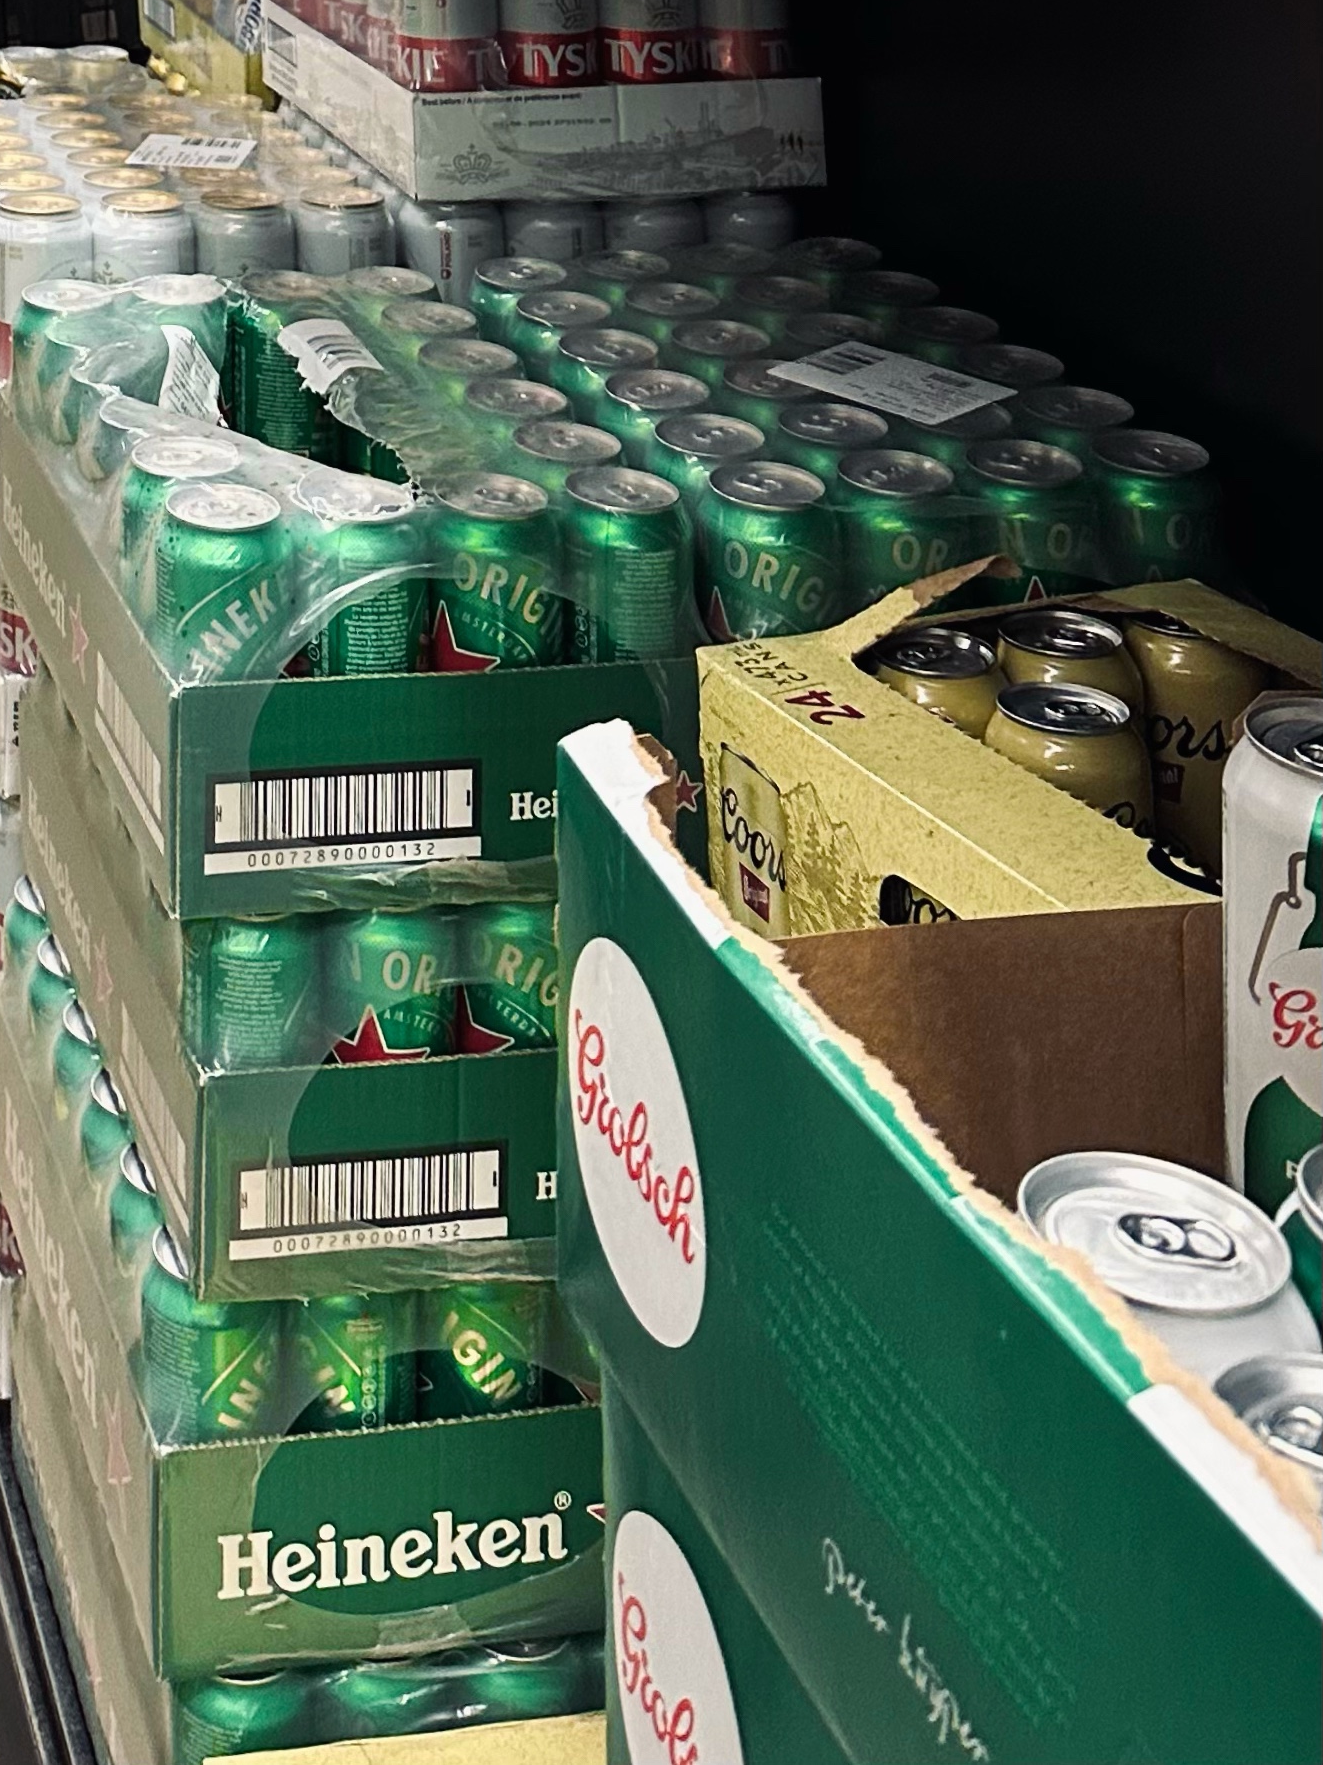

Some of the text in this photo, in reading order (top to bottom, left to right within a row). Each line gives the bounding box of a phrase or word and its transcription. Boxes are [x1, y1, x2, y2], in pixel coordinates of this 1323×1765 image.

[783, 689, 866, 726] 24
[720, 785, 787, 893] Coors
[573, 1005, 696, 1265] Grolsch
[216, 1505, 569, 1601] Heineken
